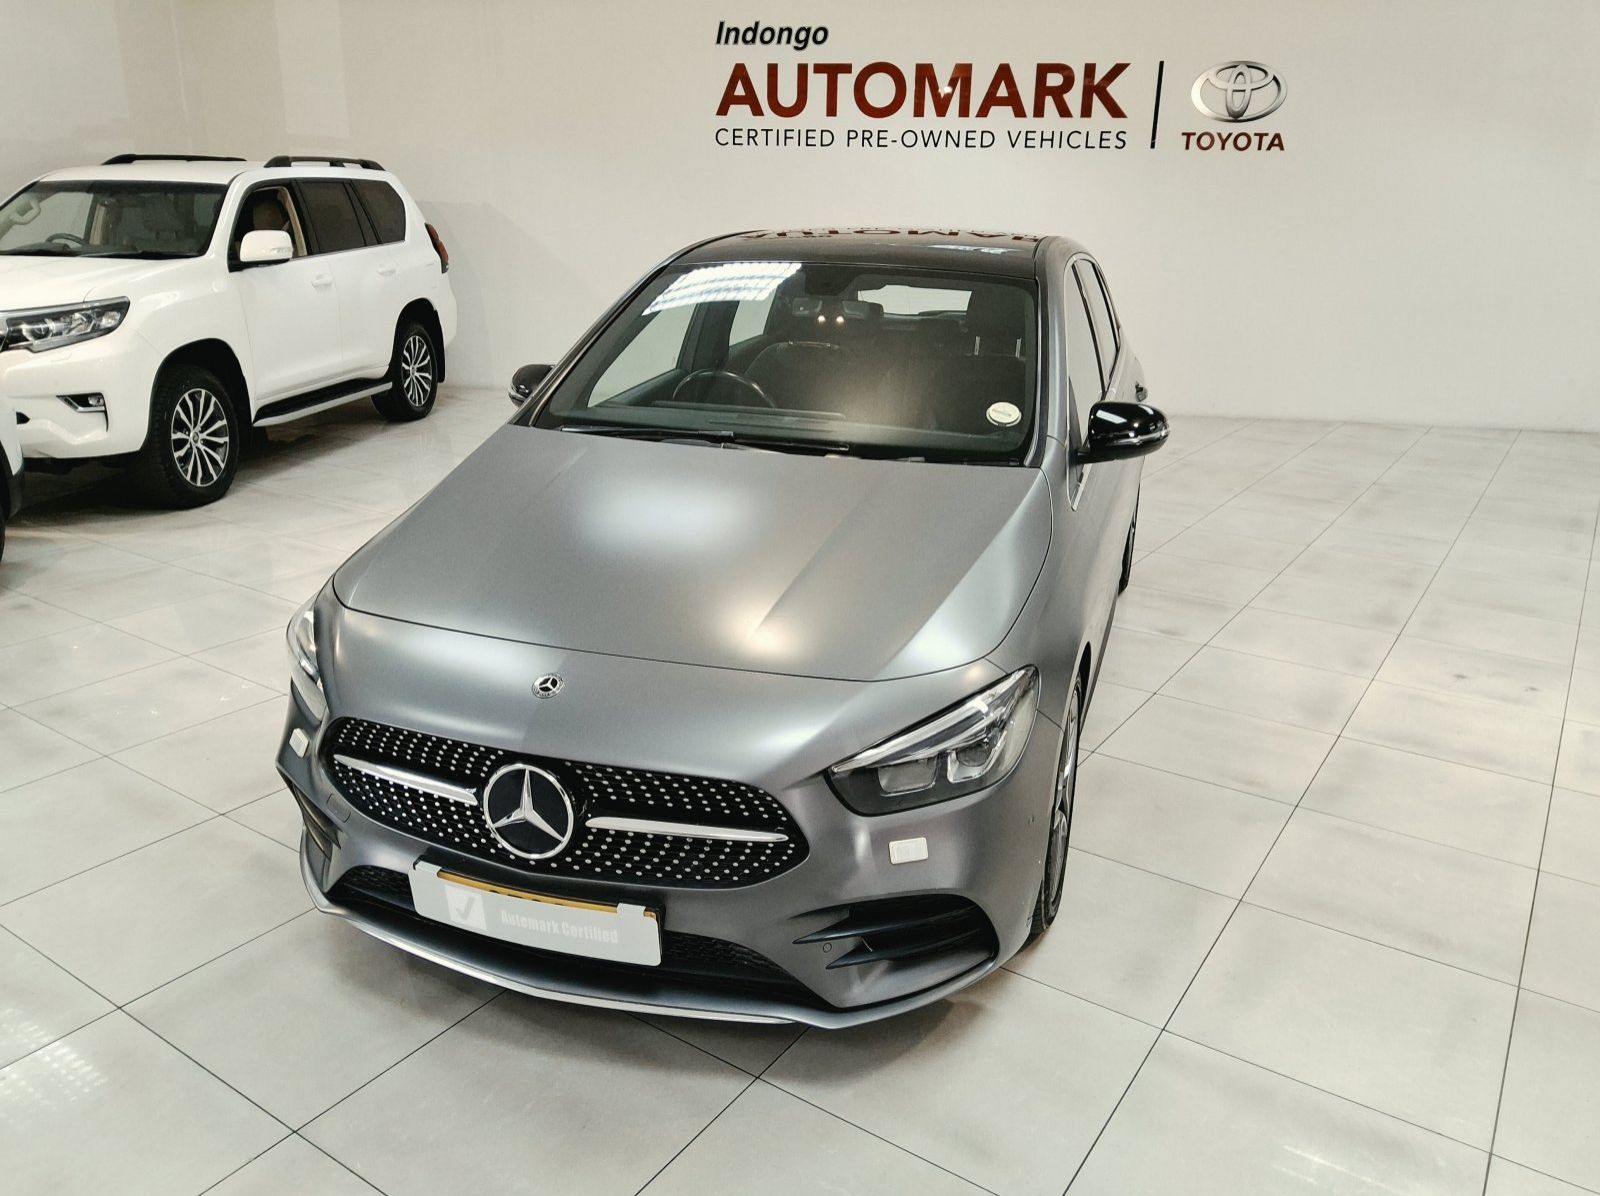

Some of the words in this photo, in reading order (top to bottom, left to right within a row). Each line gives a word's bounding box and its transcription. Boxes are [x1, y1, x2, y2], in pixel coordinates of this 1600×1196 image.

[715, 20, 829, 51] Indongo
[715, 61, 1132, 119] AUTOMARK
[715, 127, 835, 147] CERTIFIED
[846, 129, 996, 149] PRE-OWNED
[1007, 130, 1127, 150] VEHICLES
[1181, 131, 1285, 152] TOYOTA
[500, 909, 560, 935] Automark
[561, 920, 619, 944] Certified
